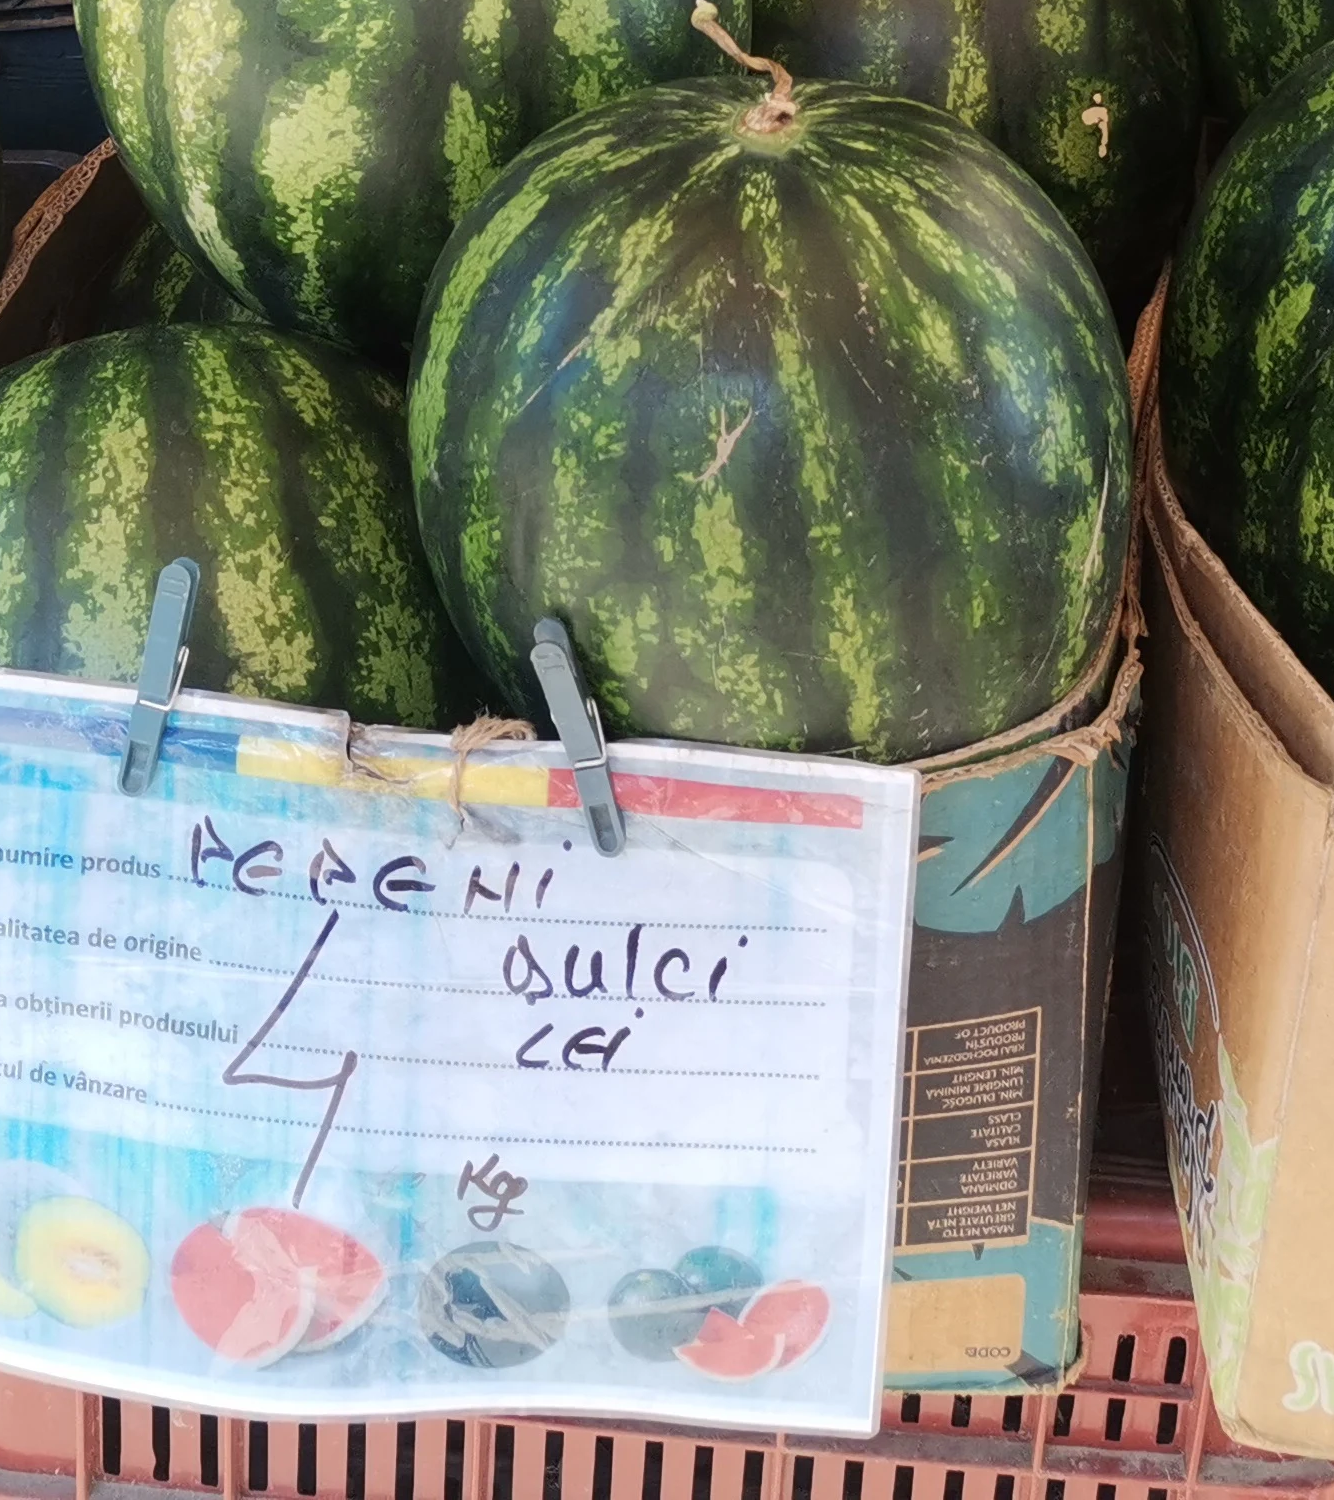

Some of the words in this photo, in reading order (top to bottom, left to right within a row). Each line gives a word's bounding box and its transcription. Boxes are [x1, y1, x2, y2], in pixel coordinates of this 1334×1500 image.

[81, 854, 162, 881] produs
[87, 927, 118, 950] de
[123, 933, 203, 962] origine
[14, 993, 113, 1020] obținerii
[118, 1007, 240, 1045] produsului
[972, 1019, 1026, 1037] PRODUCT
[222, 908, 358, 1210] 4
[29, 1061, 58, 1086] de
[63, 1070, 149, 1103] vânzare
[988, 1112, 1021, 1125] CLASS
[970, 1123, 1021, 1138] CALITATE
[985, 1135, 1020, 1148] KLASA
[973, 1156, 1018, 1171] VARIETY
[961, 1180, 1017, 1194] ODMIANA
[947, 1204, 992, 1216] WEIGHT
[996, 1201, 1017, 1212] NET
[982, 1223, 1015, 1234] MASA
